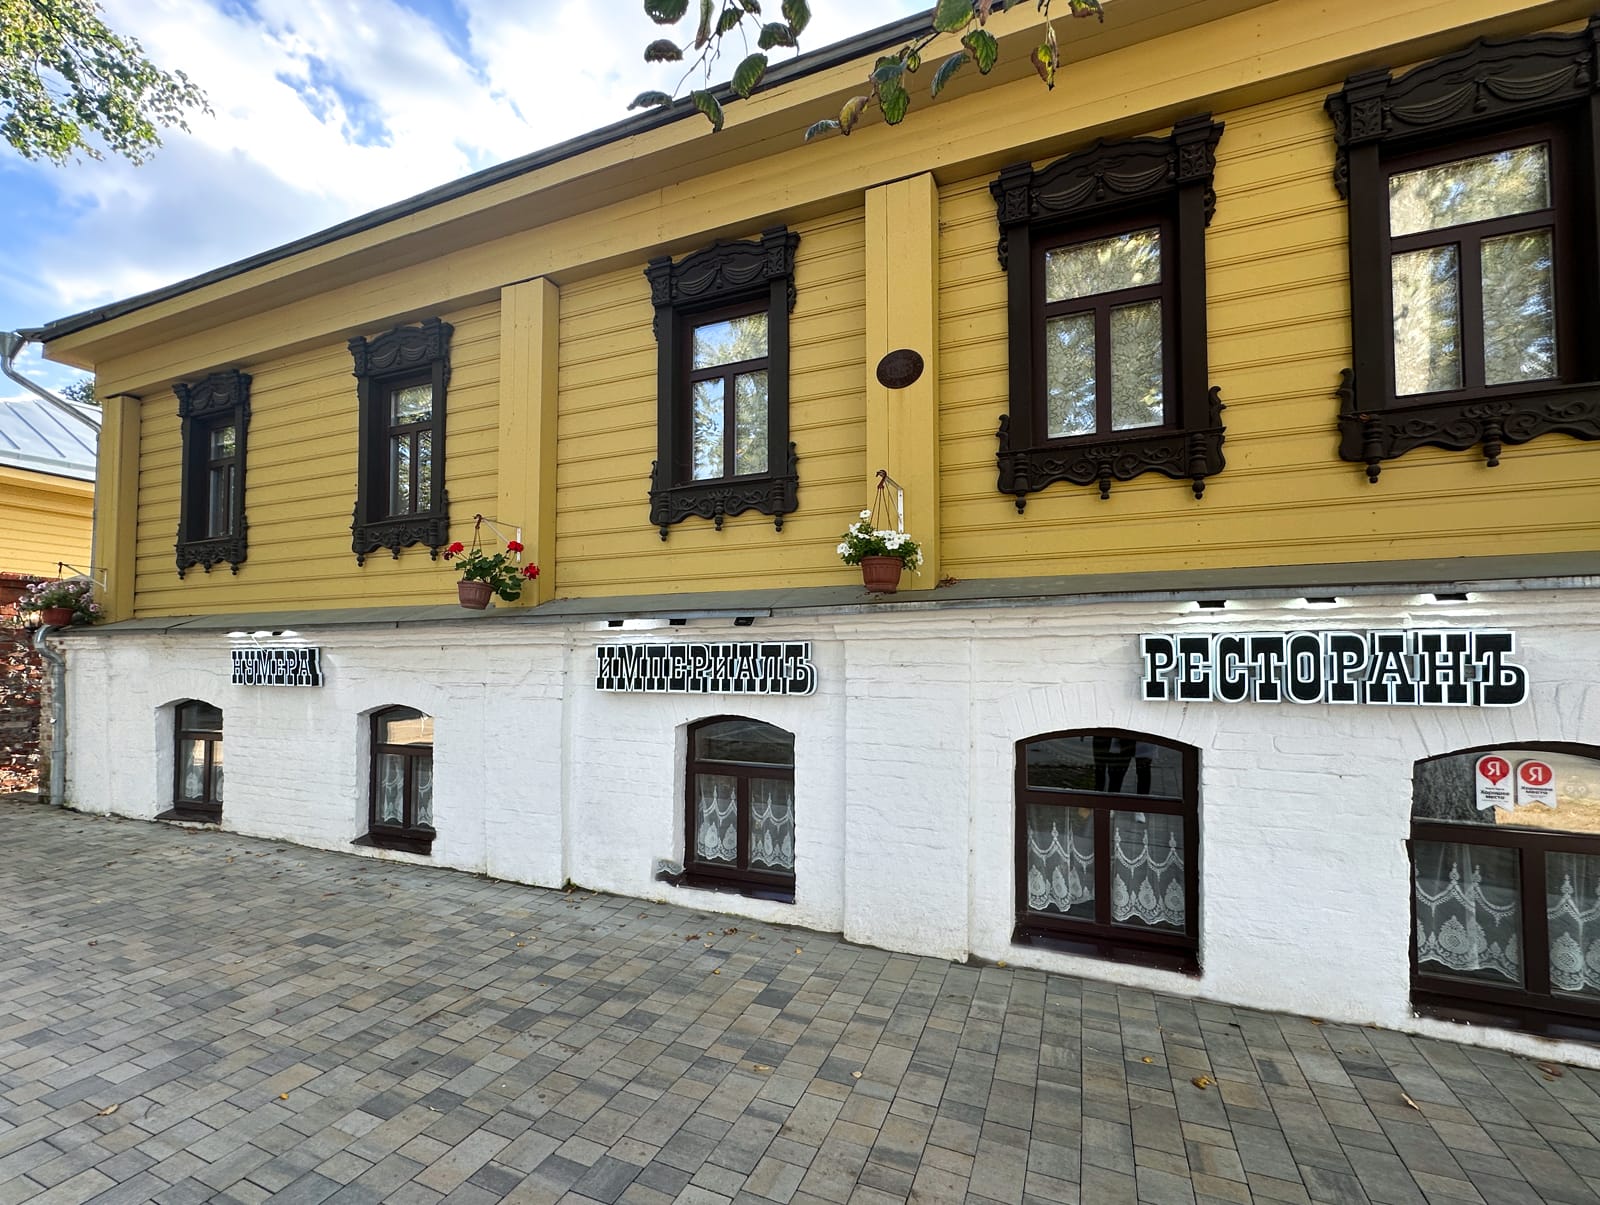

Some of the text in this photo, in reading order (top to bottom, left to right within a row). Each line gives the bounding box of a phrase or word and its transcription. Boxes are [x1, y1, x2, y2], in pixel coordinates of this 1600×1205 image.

[231, 648, 321, 687] НУМЕРА
[595, 642, 817, 696] ИМПЕРИАЛЪ
[1139, 630, 1529, 707] РЕСТОРАНЪ
[1487, 761, 1501, 776] Я
[1528, 766, 1543, 782] Я
